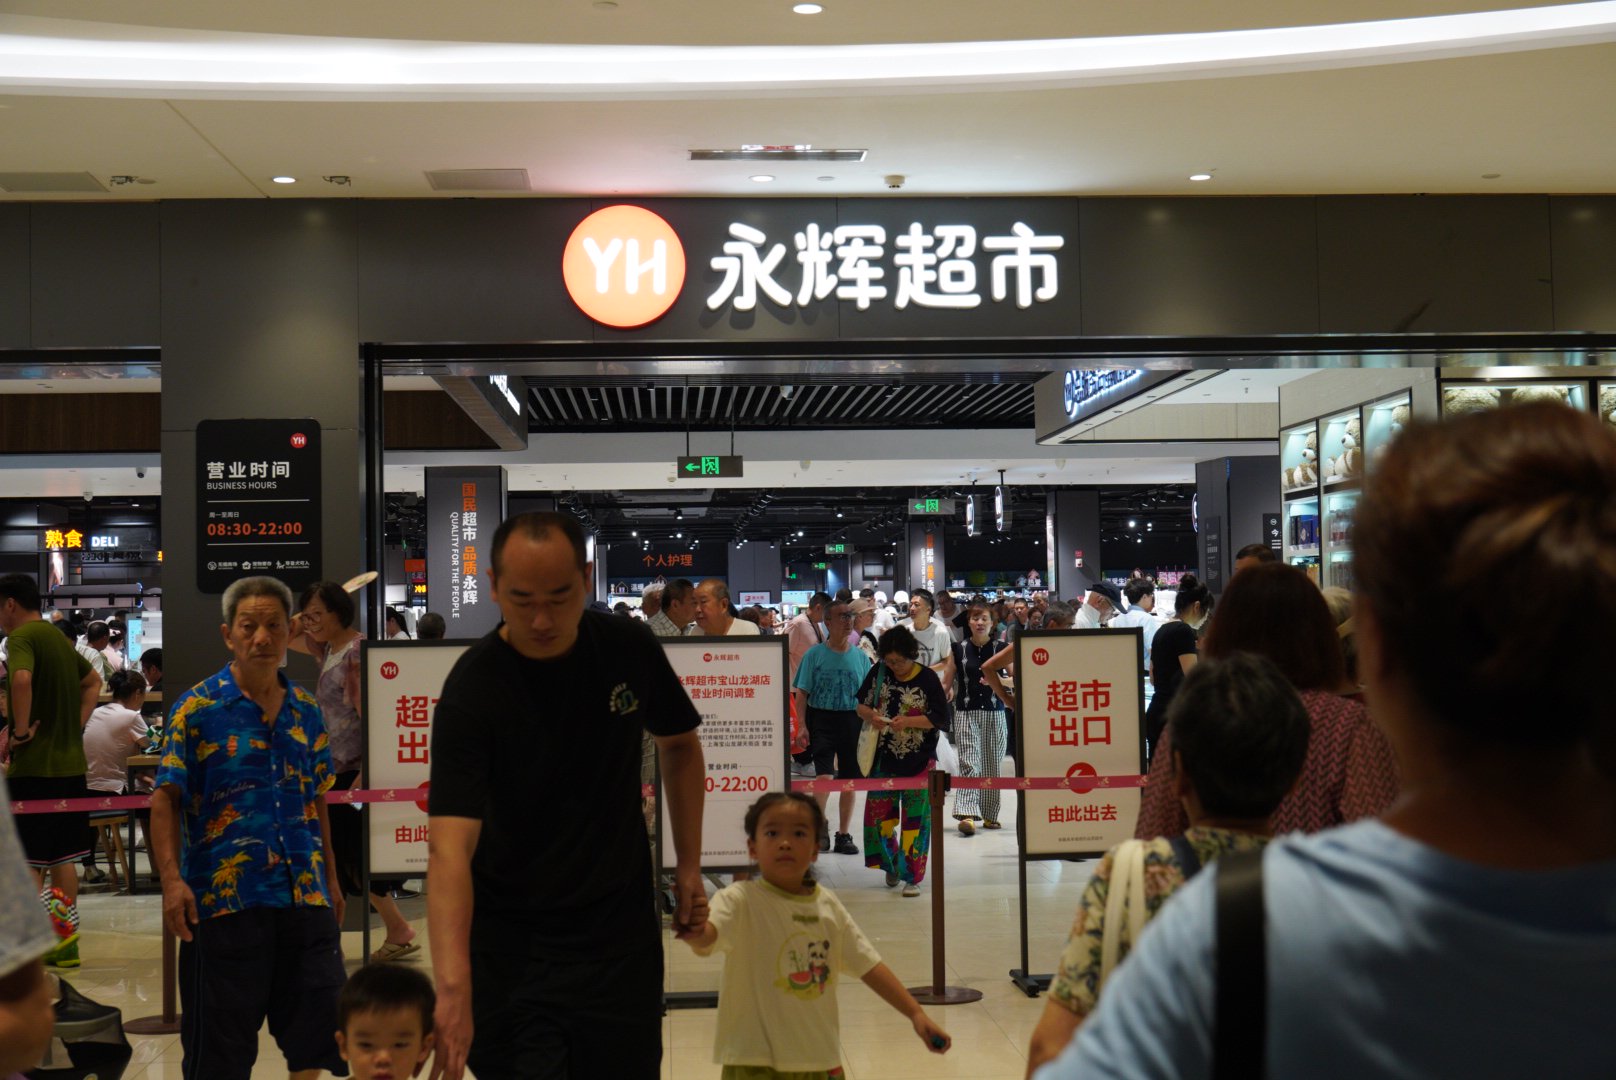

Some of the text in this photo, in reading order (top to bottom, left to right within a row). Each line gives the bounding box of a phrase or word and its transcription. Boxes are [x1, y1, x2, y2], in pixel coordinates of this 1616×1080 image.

[583, 238, 666, 295] YH
[706, 222, 1064, 311] 永辉超市
[292, 436, 305, 445] YH
[206, 461, 290, 479] 营业时间
[206, 481, 277, 490] BUSINESS HOURS
[207, 522, 302, 536] 08:30-22:00
[45, 529, 83, 548] 熟食
[91, 536, 118, 547] DELI
[462, 482, 478, 605] 国民超市 品质永辉
[449, 511, 460, 619] QUALITY FOR THE PEOPLE
[642, 554, 693, 567] 个人护理
[1033, 652, 1048, 661] YH
[383, 666, 397, 675] YH
[691, 688, 755, 699] 营业时间调整
[1047, 679, 1111, 712] 超市
[396, 695, 441, 728] 超
[1049, 715, 1111, 747] 出口
[1048, 804, 1118, 823] 由此出去
[395, 825, 430, 843] 由此
